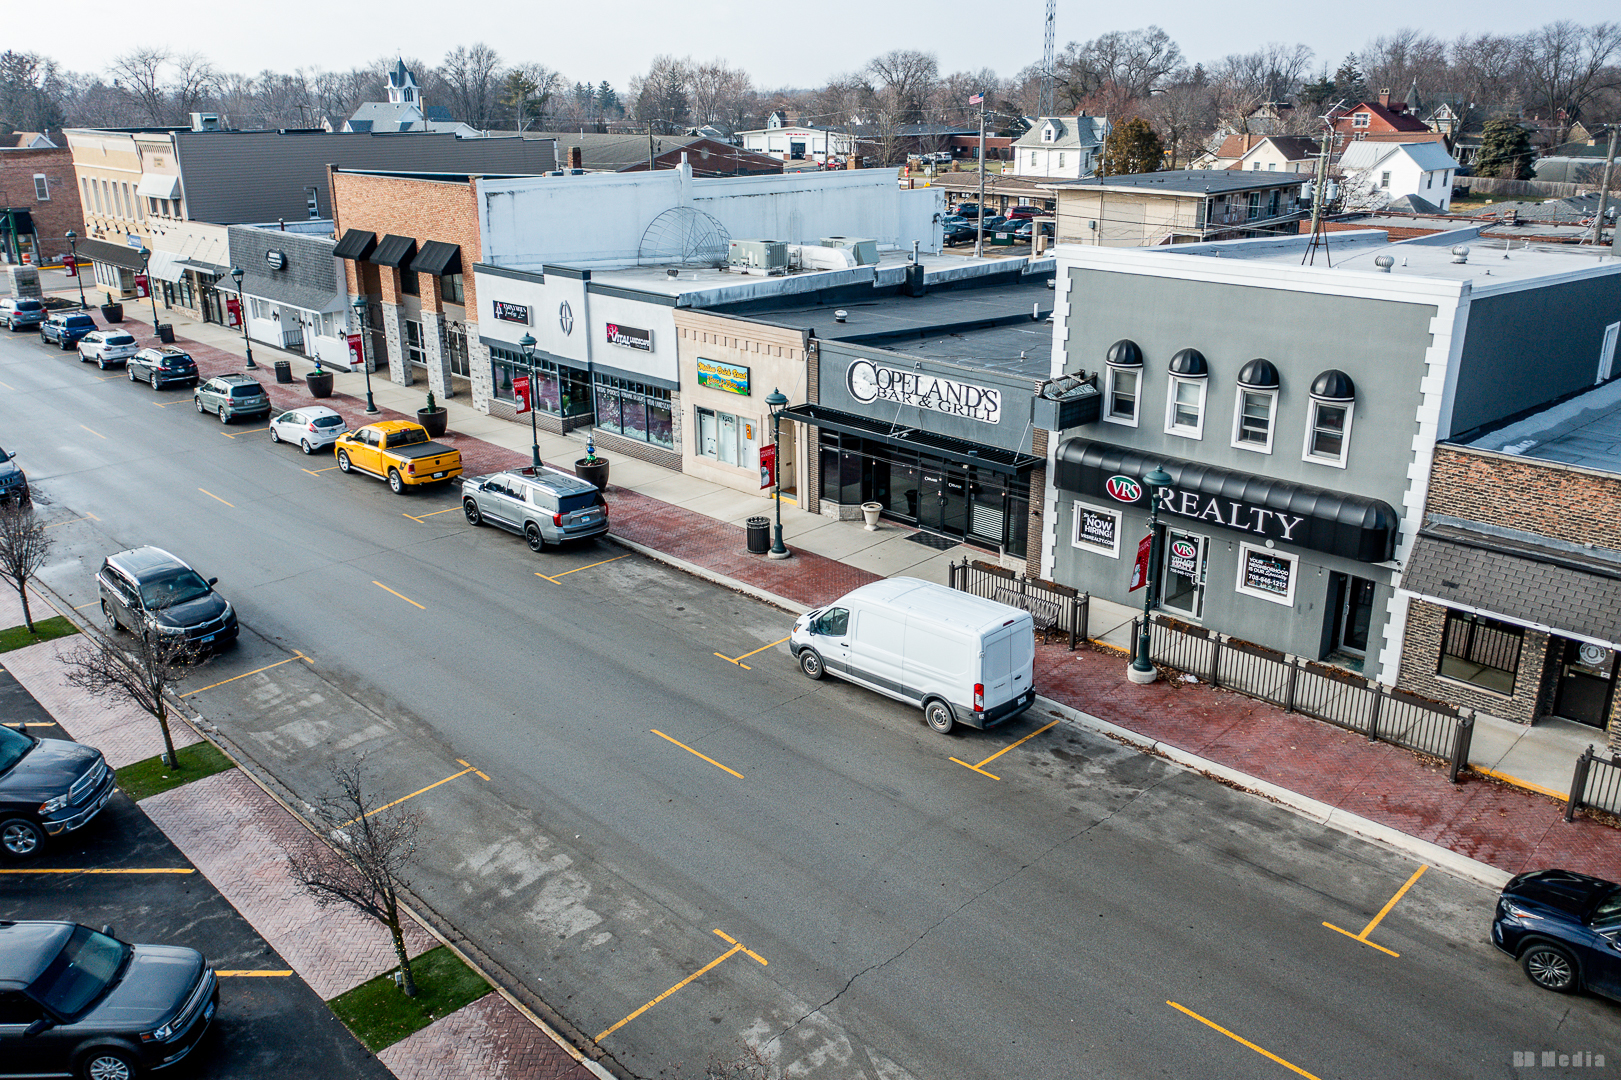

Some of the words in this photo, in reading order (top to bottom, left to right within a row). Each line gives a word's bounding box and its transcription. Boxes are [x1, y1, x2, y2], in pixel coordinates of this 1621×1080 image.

[717, 366, 731, 376] Brick
[732, 369, 747, 380] Road
[847, 360, 998, 412] COPELAND'S
[877, 387, 912, 404] BAR
[918, 395, 932, 409] &
[938, 400, 998, 423] GRILL
[1112, 479, 1139, 499] VRS
[1158, 487, 1303, 540] REALTY
[1086, 517, 1112, 530] NOW
[1085, 524, 1112, 538] HIRING!
[1176, 543, 1194, 555] VRS
[1249, 557, 1263, 565] YOUR
